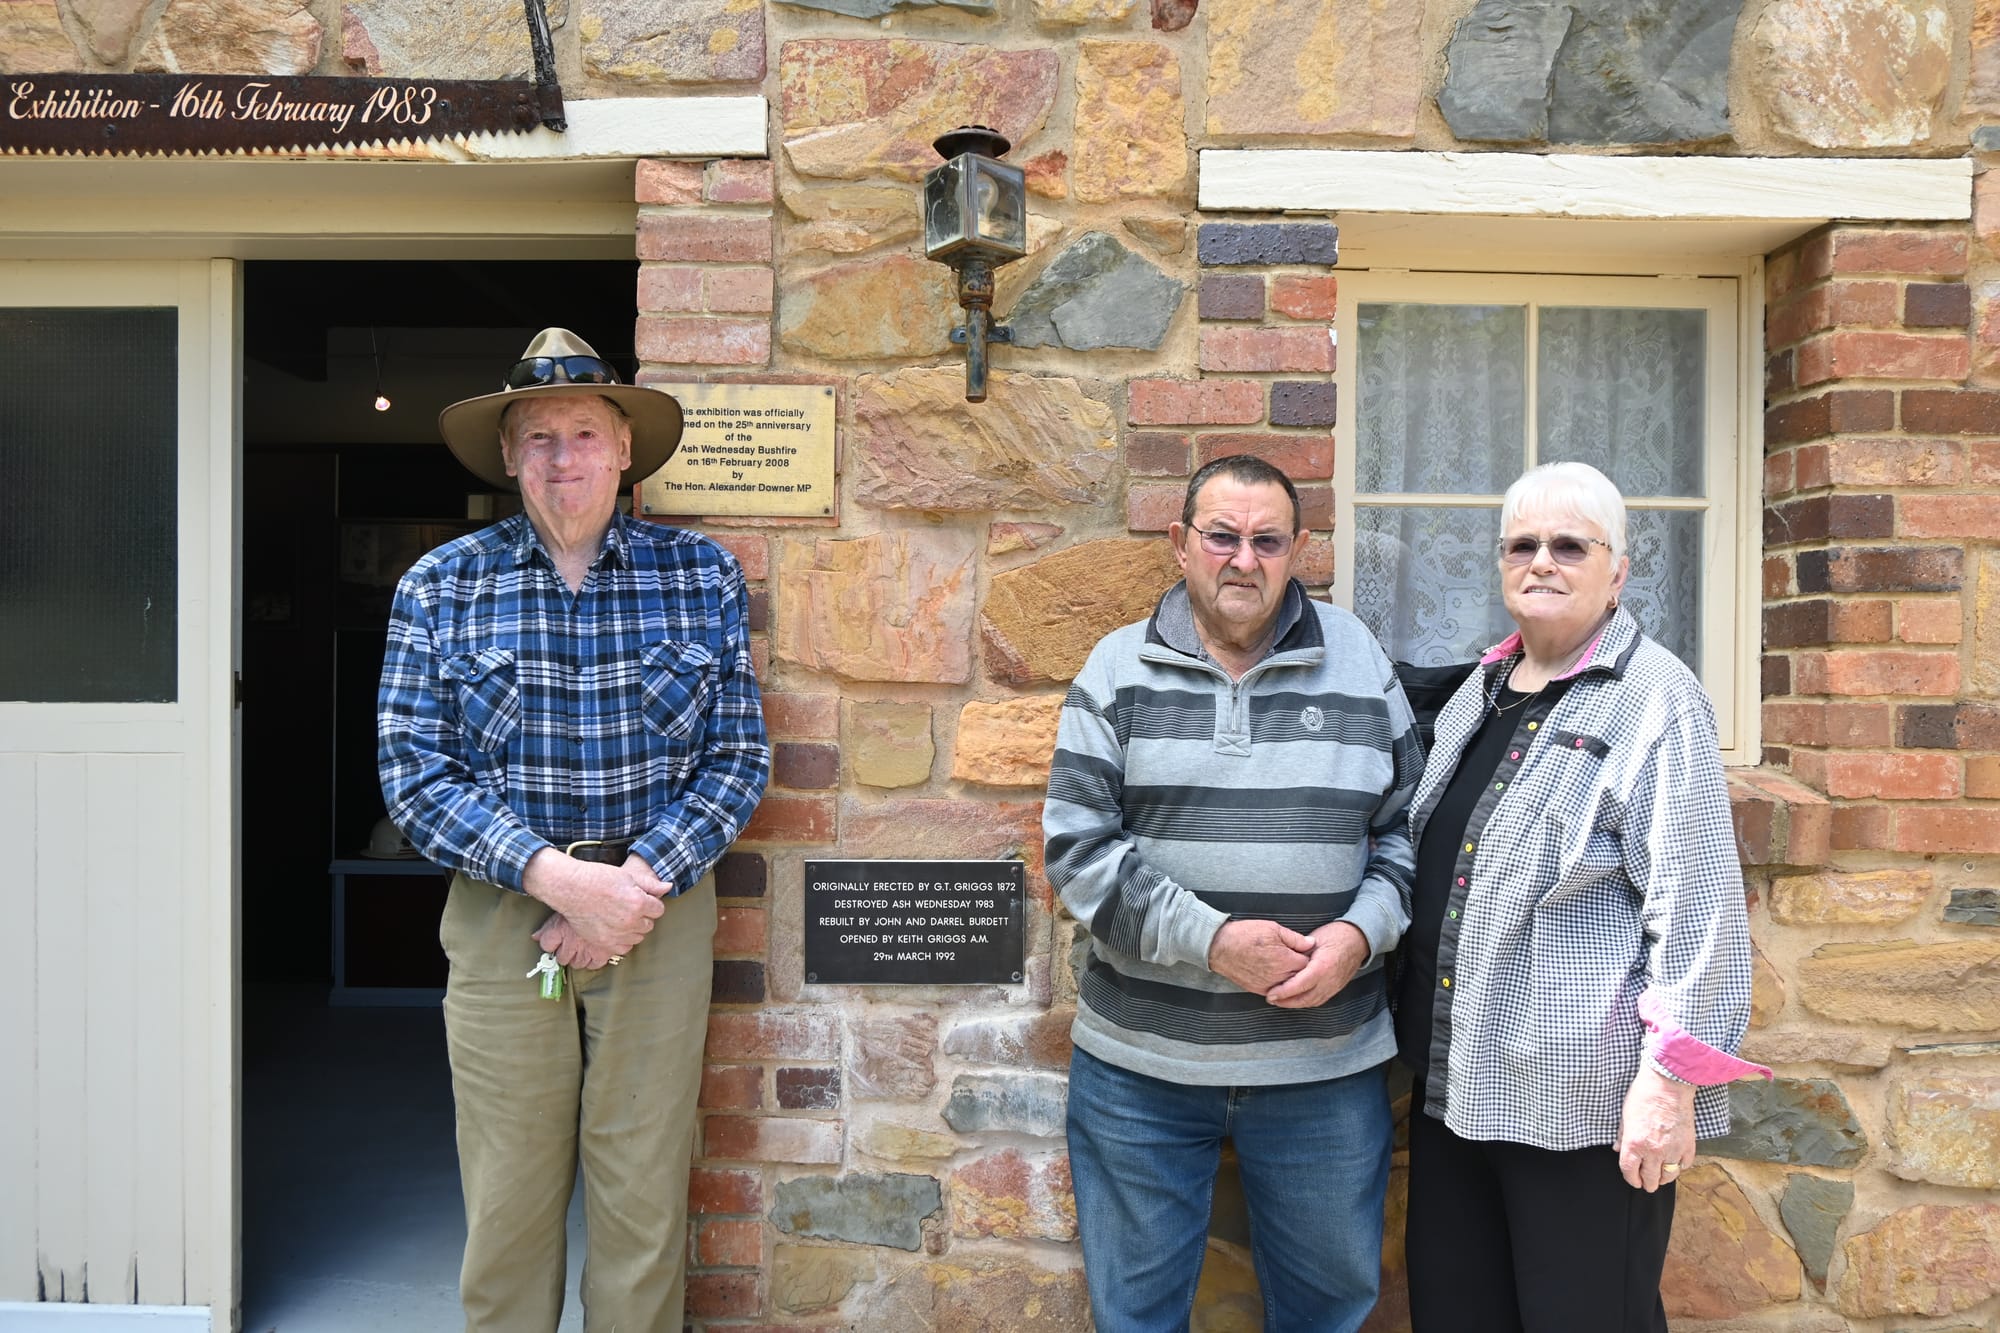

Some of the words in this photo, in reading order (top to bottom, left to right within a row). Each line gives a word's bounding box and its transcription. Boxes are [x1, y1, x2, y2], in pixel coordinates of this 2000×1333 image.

[9, 81, 142, 120] Exhibition
[170, 81, 226, 120] 16th
[231, 82, 355, 135] February
[361, 86, 437, 125] 1983
[696, 408, 740, 417] exhibition
[743, 409, 762, 417] was
[765, 408, 804, 419] officially
[683, 420, 701, 428] ned
[703, 421, 716, 429] on
[718, 421, 733, 429] the
[735, 421, 754, 429] 25th
[756, 422, 811, 431] anniversary
[725, 433, 735, 441] of
[737, 433, 752, 442] the
[680, 445, 698, 453] Ash
[700, 445, 756, 456] Wednesday
[758, 446, 797, 455] Bushfire
[687, 458, 699, 466] on
[702, 458, 718, 466] 16th
[719, 458, 762, 468] February
[765, 459, 790, 467] 2008
[732, 471, 744, 480] by
[664, 481, 683, 491] The
[684, 482, 706, 491] Hon.
[708, 483, 756, 492] Alexander
[758, 483, 795, 492] Downer
[797, 484, 812, 493] MP
[812, 882, 870, 892] ORIGINALLY
[873, 882, 914, 891] ERECTED
[918, 882, 930, 891] BY
[933, 882, 952, 891] G.T.
[954, 882, 993, 892] GRIGGS
[997, 882, 1016, 892] 1872
[834, 900, 888, 909] DESTROYED
[892, 900, 911, 909] ASH
[915, 900, 971, 909] WEDNESDAY
[975, 900, 994, 909] 1983
[819, 917, 855, 926] REBUILT
[858, 917, 871, 926] BY
[874, 917, 902, 926] JOHN
[905, 917, 926, 926] AND
[930, 917, 965, 926] DARREL
[969, 917, 1009, 926] BURDETT
[840, 934, 878, 944] OPENED
[882, 934, 894, 944] BY
[897, 934, 924, 944] KEITH
[927, 934, 966, 944] GRIGGS
[970, 934, 989, 944] A.M.
[896, 952, 931, 961] MARCH
[935, 952, 956, 961] 1992
